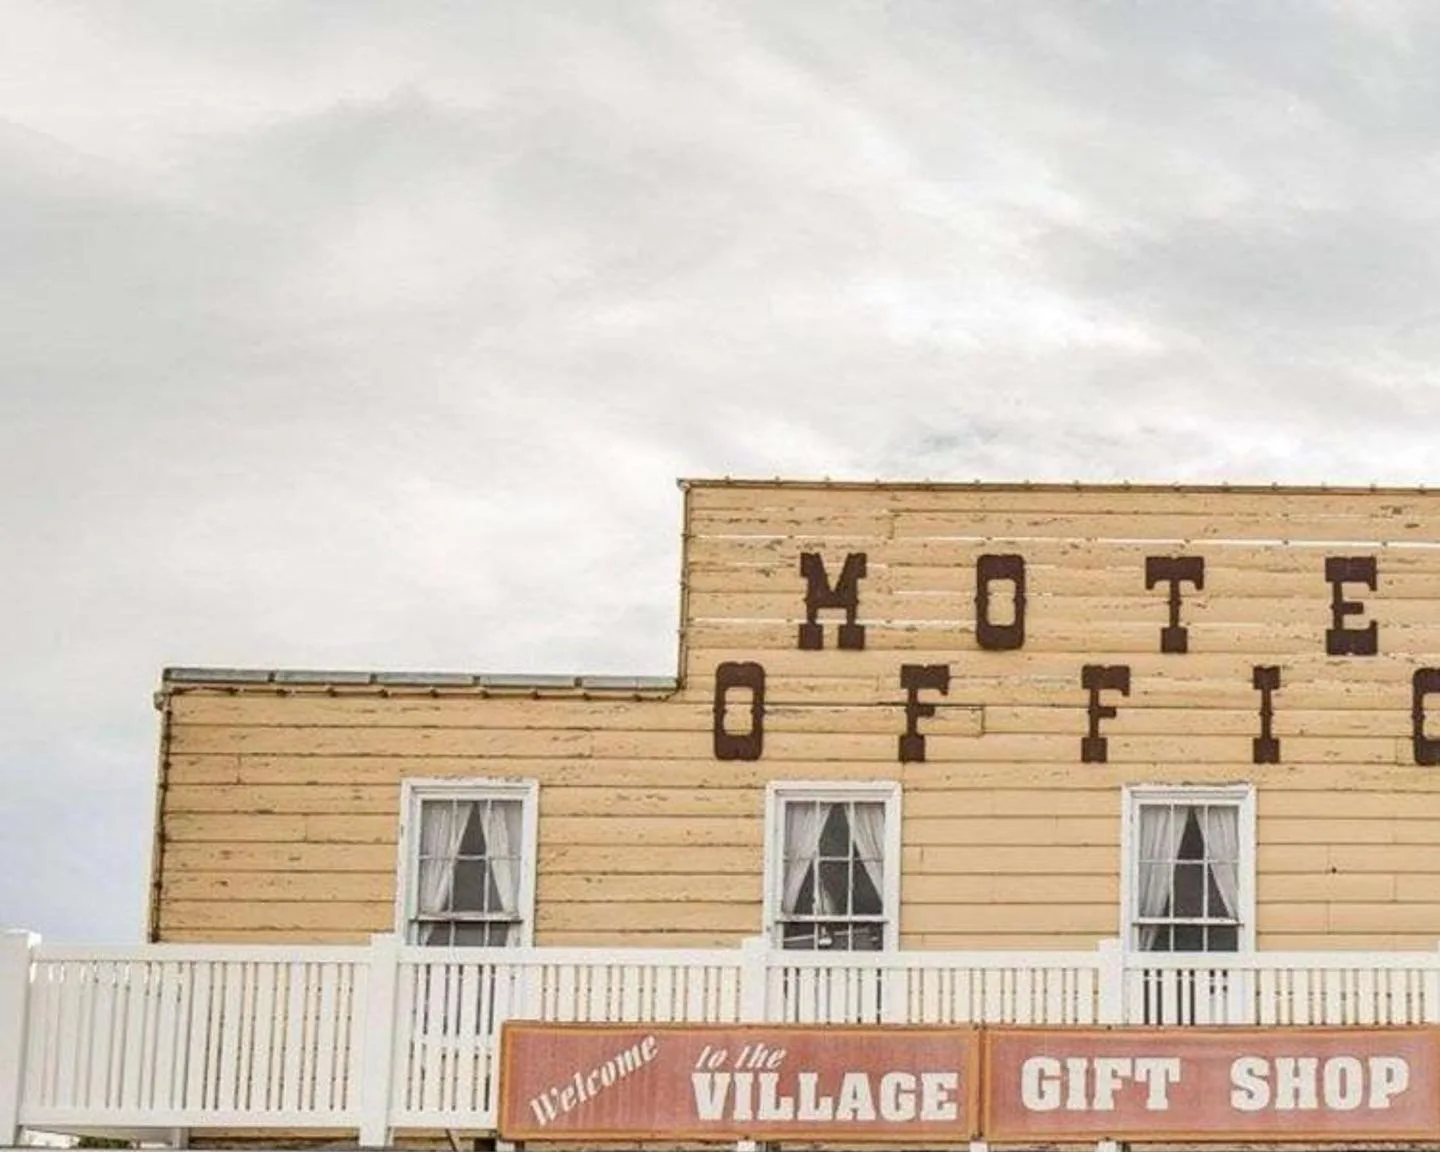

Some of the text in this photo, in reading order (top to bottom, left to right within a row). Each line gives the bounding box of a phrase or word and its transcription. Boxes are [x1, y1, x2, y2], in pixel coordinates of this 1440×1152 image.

[528, 1031, 661, 1127] Welcome
[692, 1045, 784, 1071] to the
[1020, 1056, 1409, 1112] GIFT SHOP
[691, 1071, 958, 1122] VILLAGE
